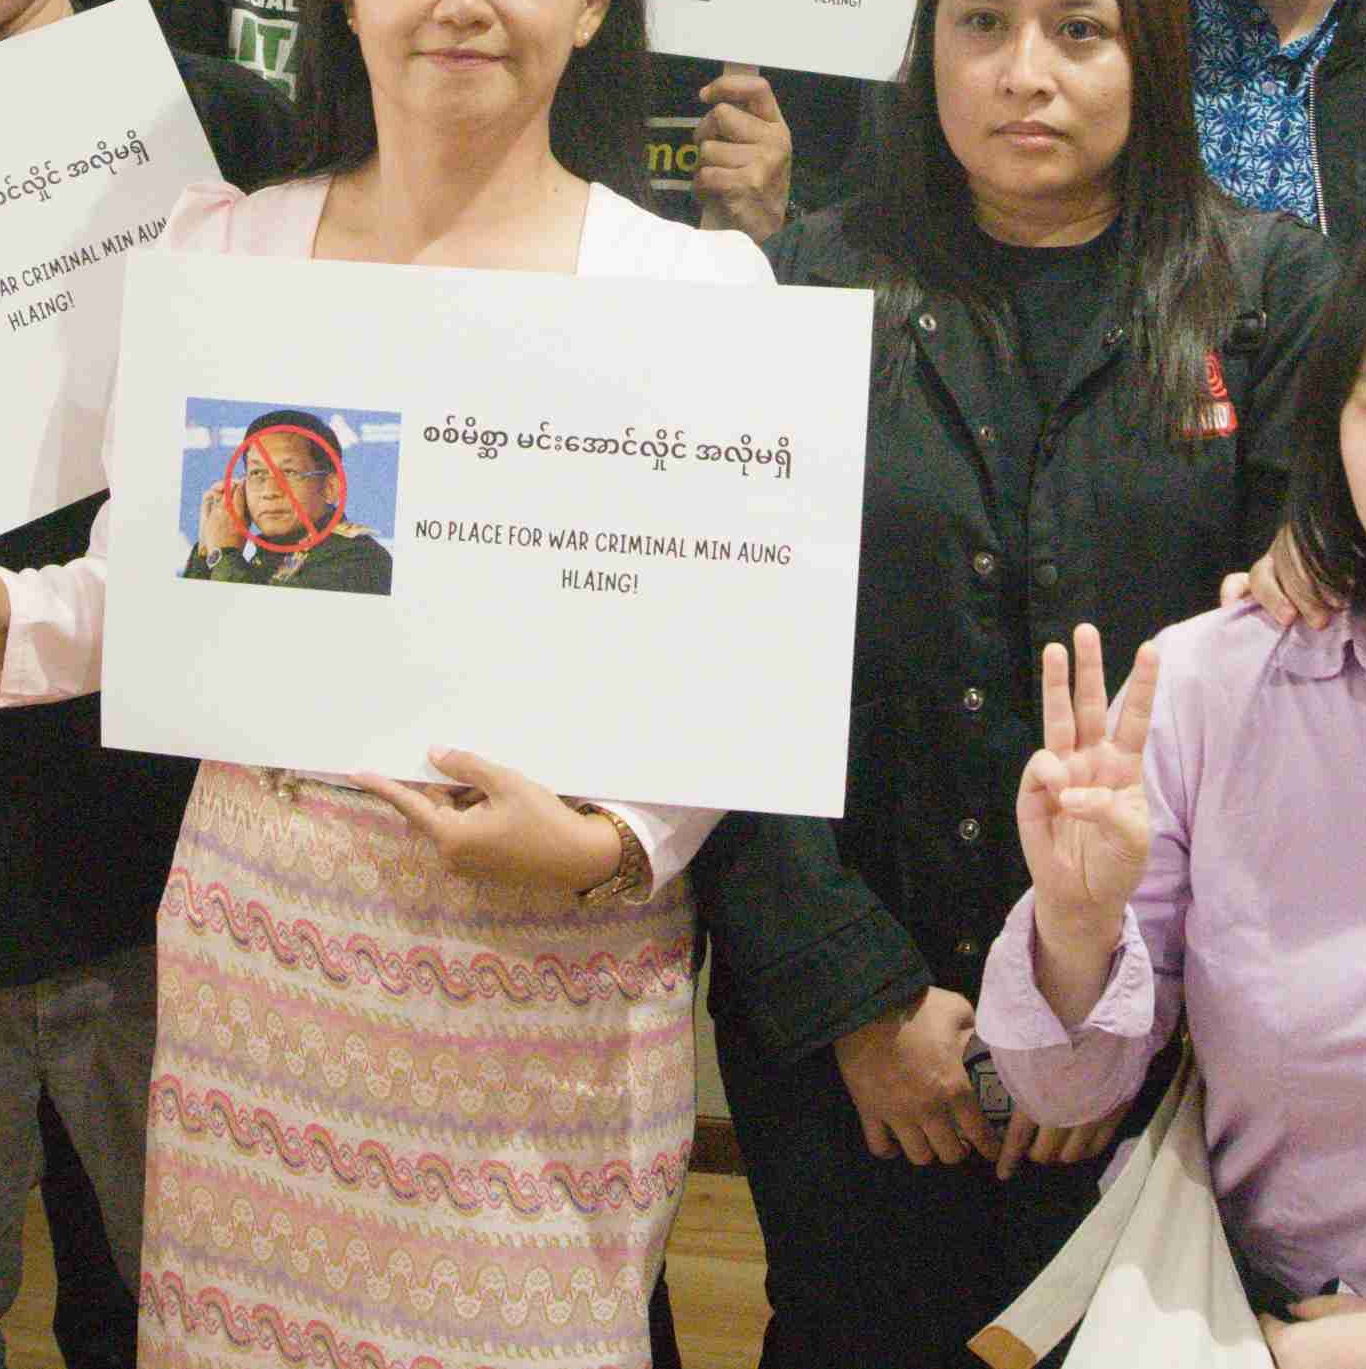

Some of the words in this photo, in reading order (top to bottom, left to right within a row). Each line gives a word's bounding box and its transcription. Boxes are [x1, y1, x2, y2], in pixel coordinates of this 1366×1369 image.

[22, 245, 100, 286] CRIMINAL
[102, 231, 134, 256] MIN
[8, 291, 75, 331] HLAING!
[416, 520, 442, 540] NO
[448, 521, 502, 544] PLACE
[509, 526, 542, 547] FOR
[549, 530, 589, 551] WAR
[596, 533, 686, 558] CRIMINAL
[695, 540, 731, 560] MIN
[737, 542, 791, 565] AUNG
[562, 569, 638, 594] HLAING!
